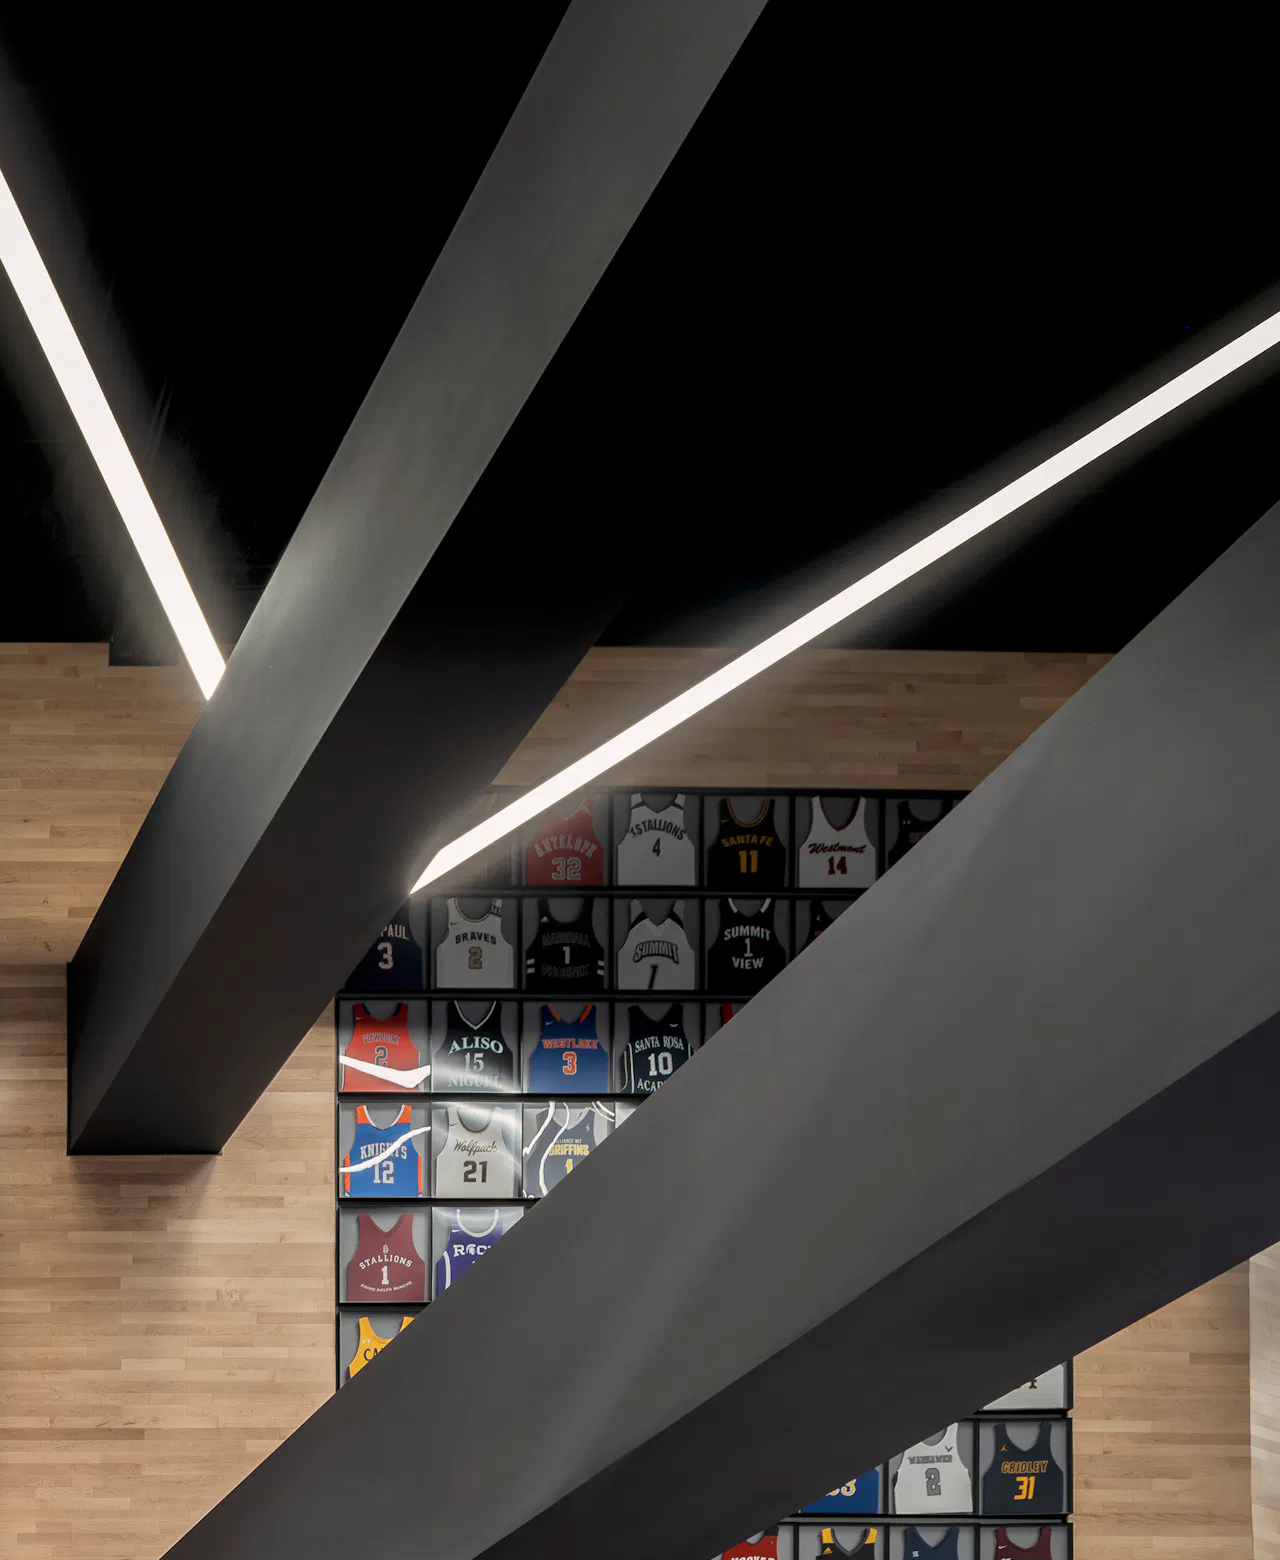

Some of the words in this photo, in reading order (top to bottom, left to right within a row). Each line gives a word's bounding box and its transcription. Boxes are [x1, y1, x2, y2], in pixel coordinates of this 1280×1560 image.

[551, 857, 581, 881] 32
[828, 856, 847, 875] 14
[724, 926, 771, 941] SUMMIT
[633, 941, 679, 964] SUMMIT
[732, 957, 764, 970] VIEW
[448, 1036, 503, 1054] ALISO
[648, 1052, 673, 1076] 10
[463, 1161, 488, 1183] 21
[359, 1255, 413, 1270] STALLIONS
[1001, 1460, 1048, 1474] GRIDLEY
[1013, 1476, 1035, 1500] 31
